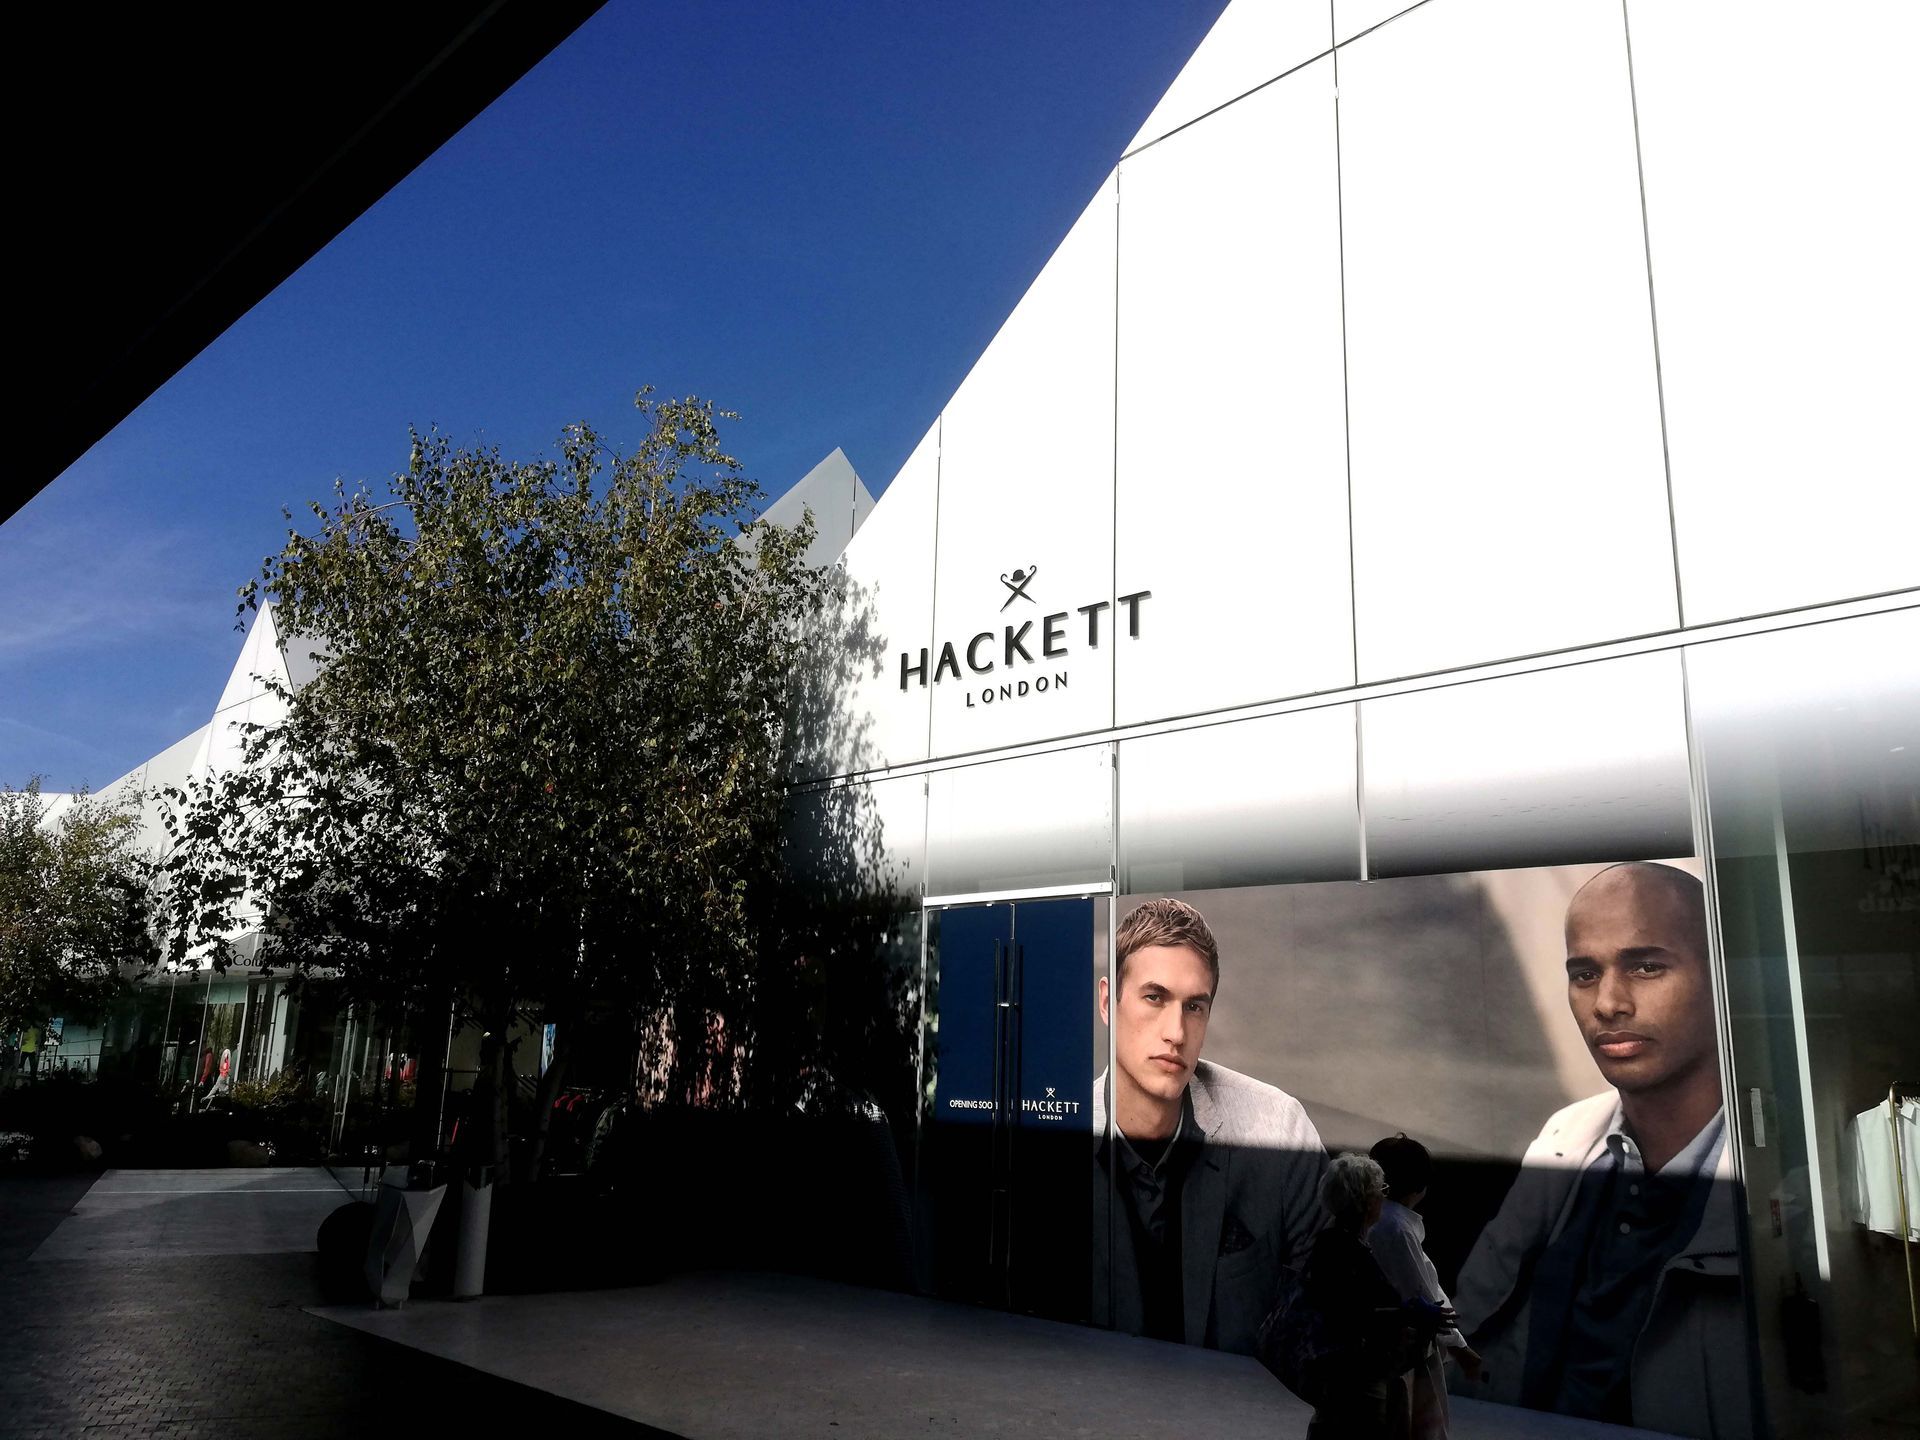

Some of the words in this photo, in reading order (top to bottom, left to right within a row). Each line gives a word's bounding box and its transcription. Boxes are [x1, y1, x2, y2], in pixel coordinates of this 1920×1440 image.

[900, 590, 1152, 692] HACKETT
[966, 671, 1068, 708] LONDON
[949, 1099, 978, 1109] OPENING
[978, 1100, 999, 1110] SOO
[1022, 1099, 1080, 1114] HACKETT
